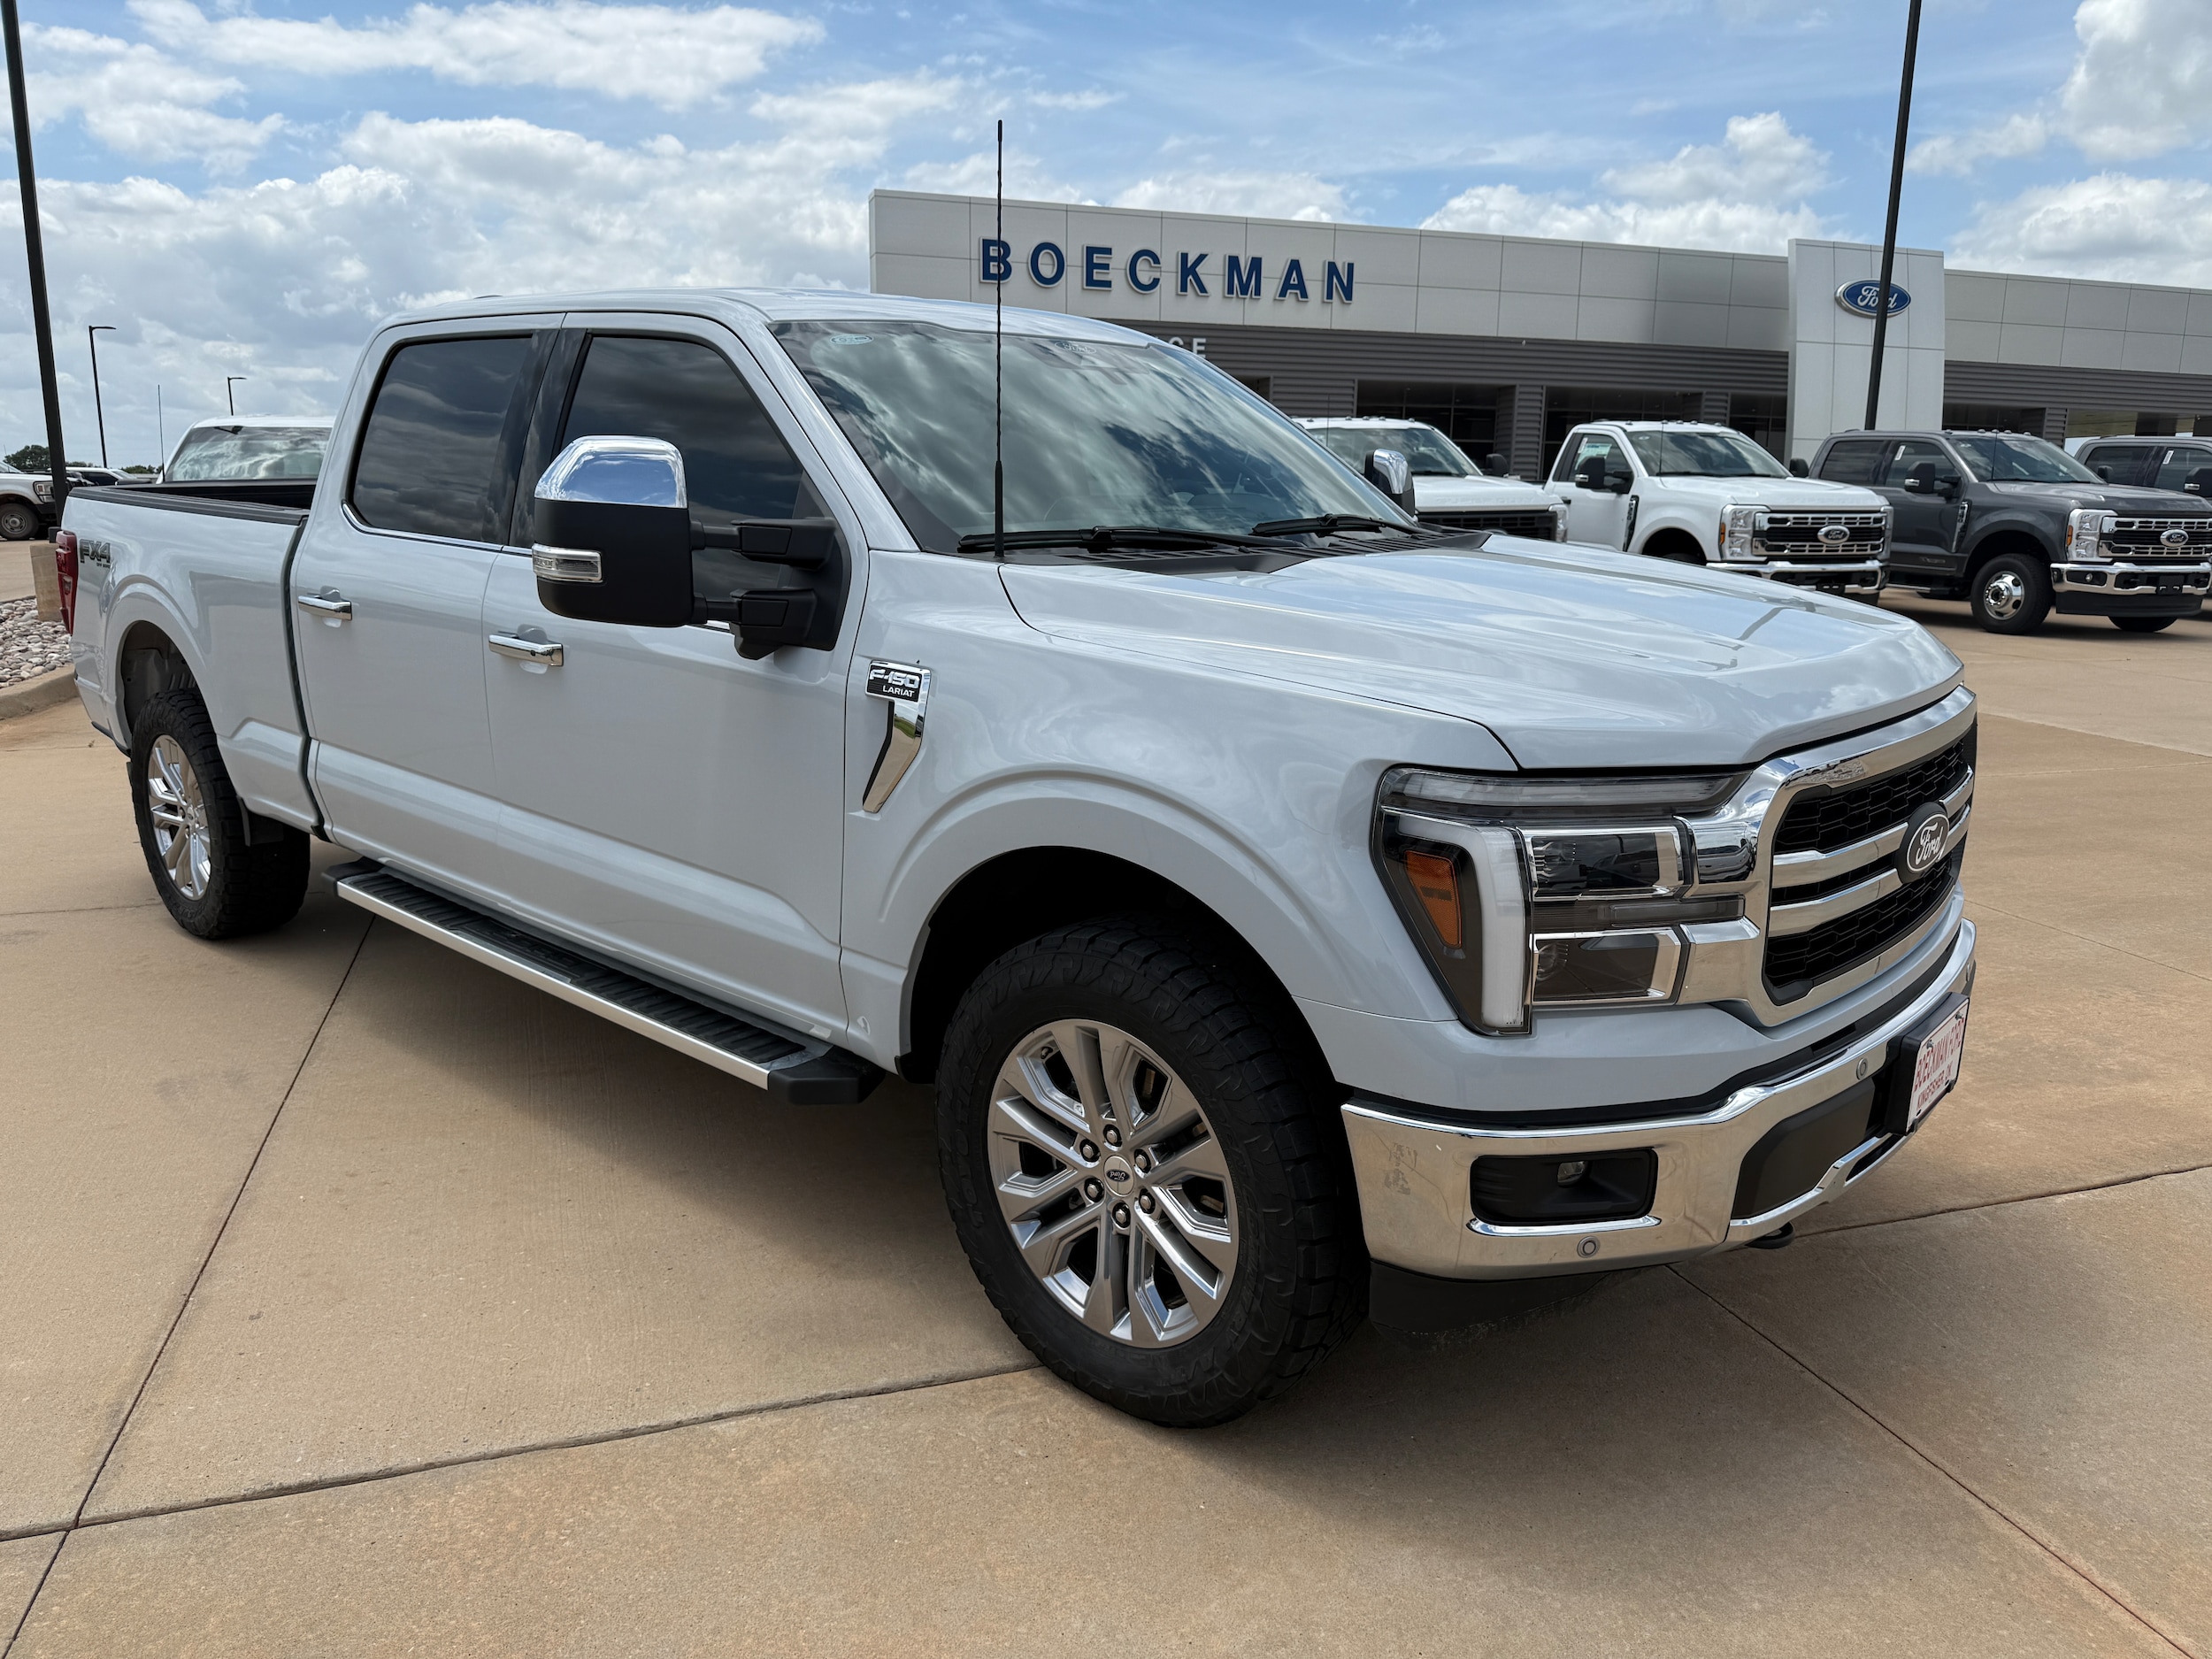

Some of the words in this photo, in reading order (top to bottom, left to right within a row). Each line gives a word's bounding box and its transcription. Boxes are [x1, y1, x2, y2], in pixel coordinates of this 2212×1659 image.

[980, 237, 1356, 303] BOECKMAN
[1856, 285, 1899, 310] Fod
[80, 539, 111, 564] FX4
[869, 669, 920, 689] F-150
[882, 685, 915, 697] LARIAT
[1915, 822, 1944, 865] Ford
[1110, 1171, 1126, 1181] Ford
